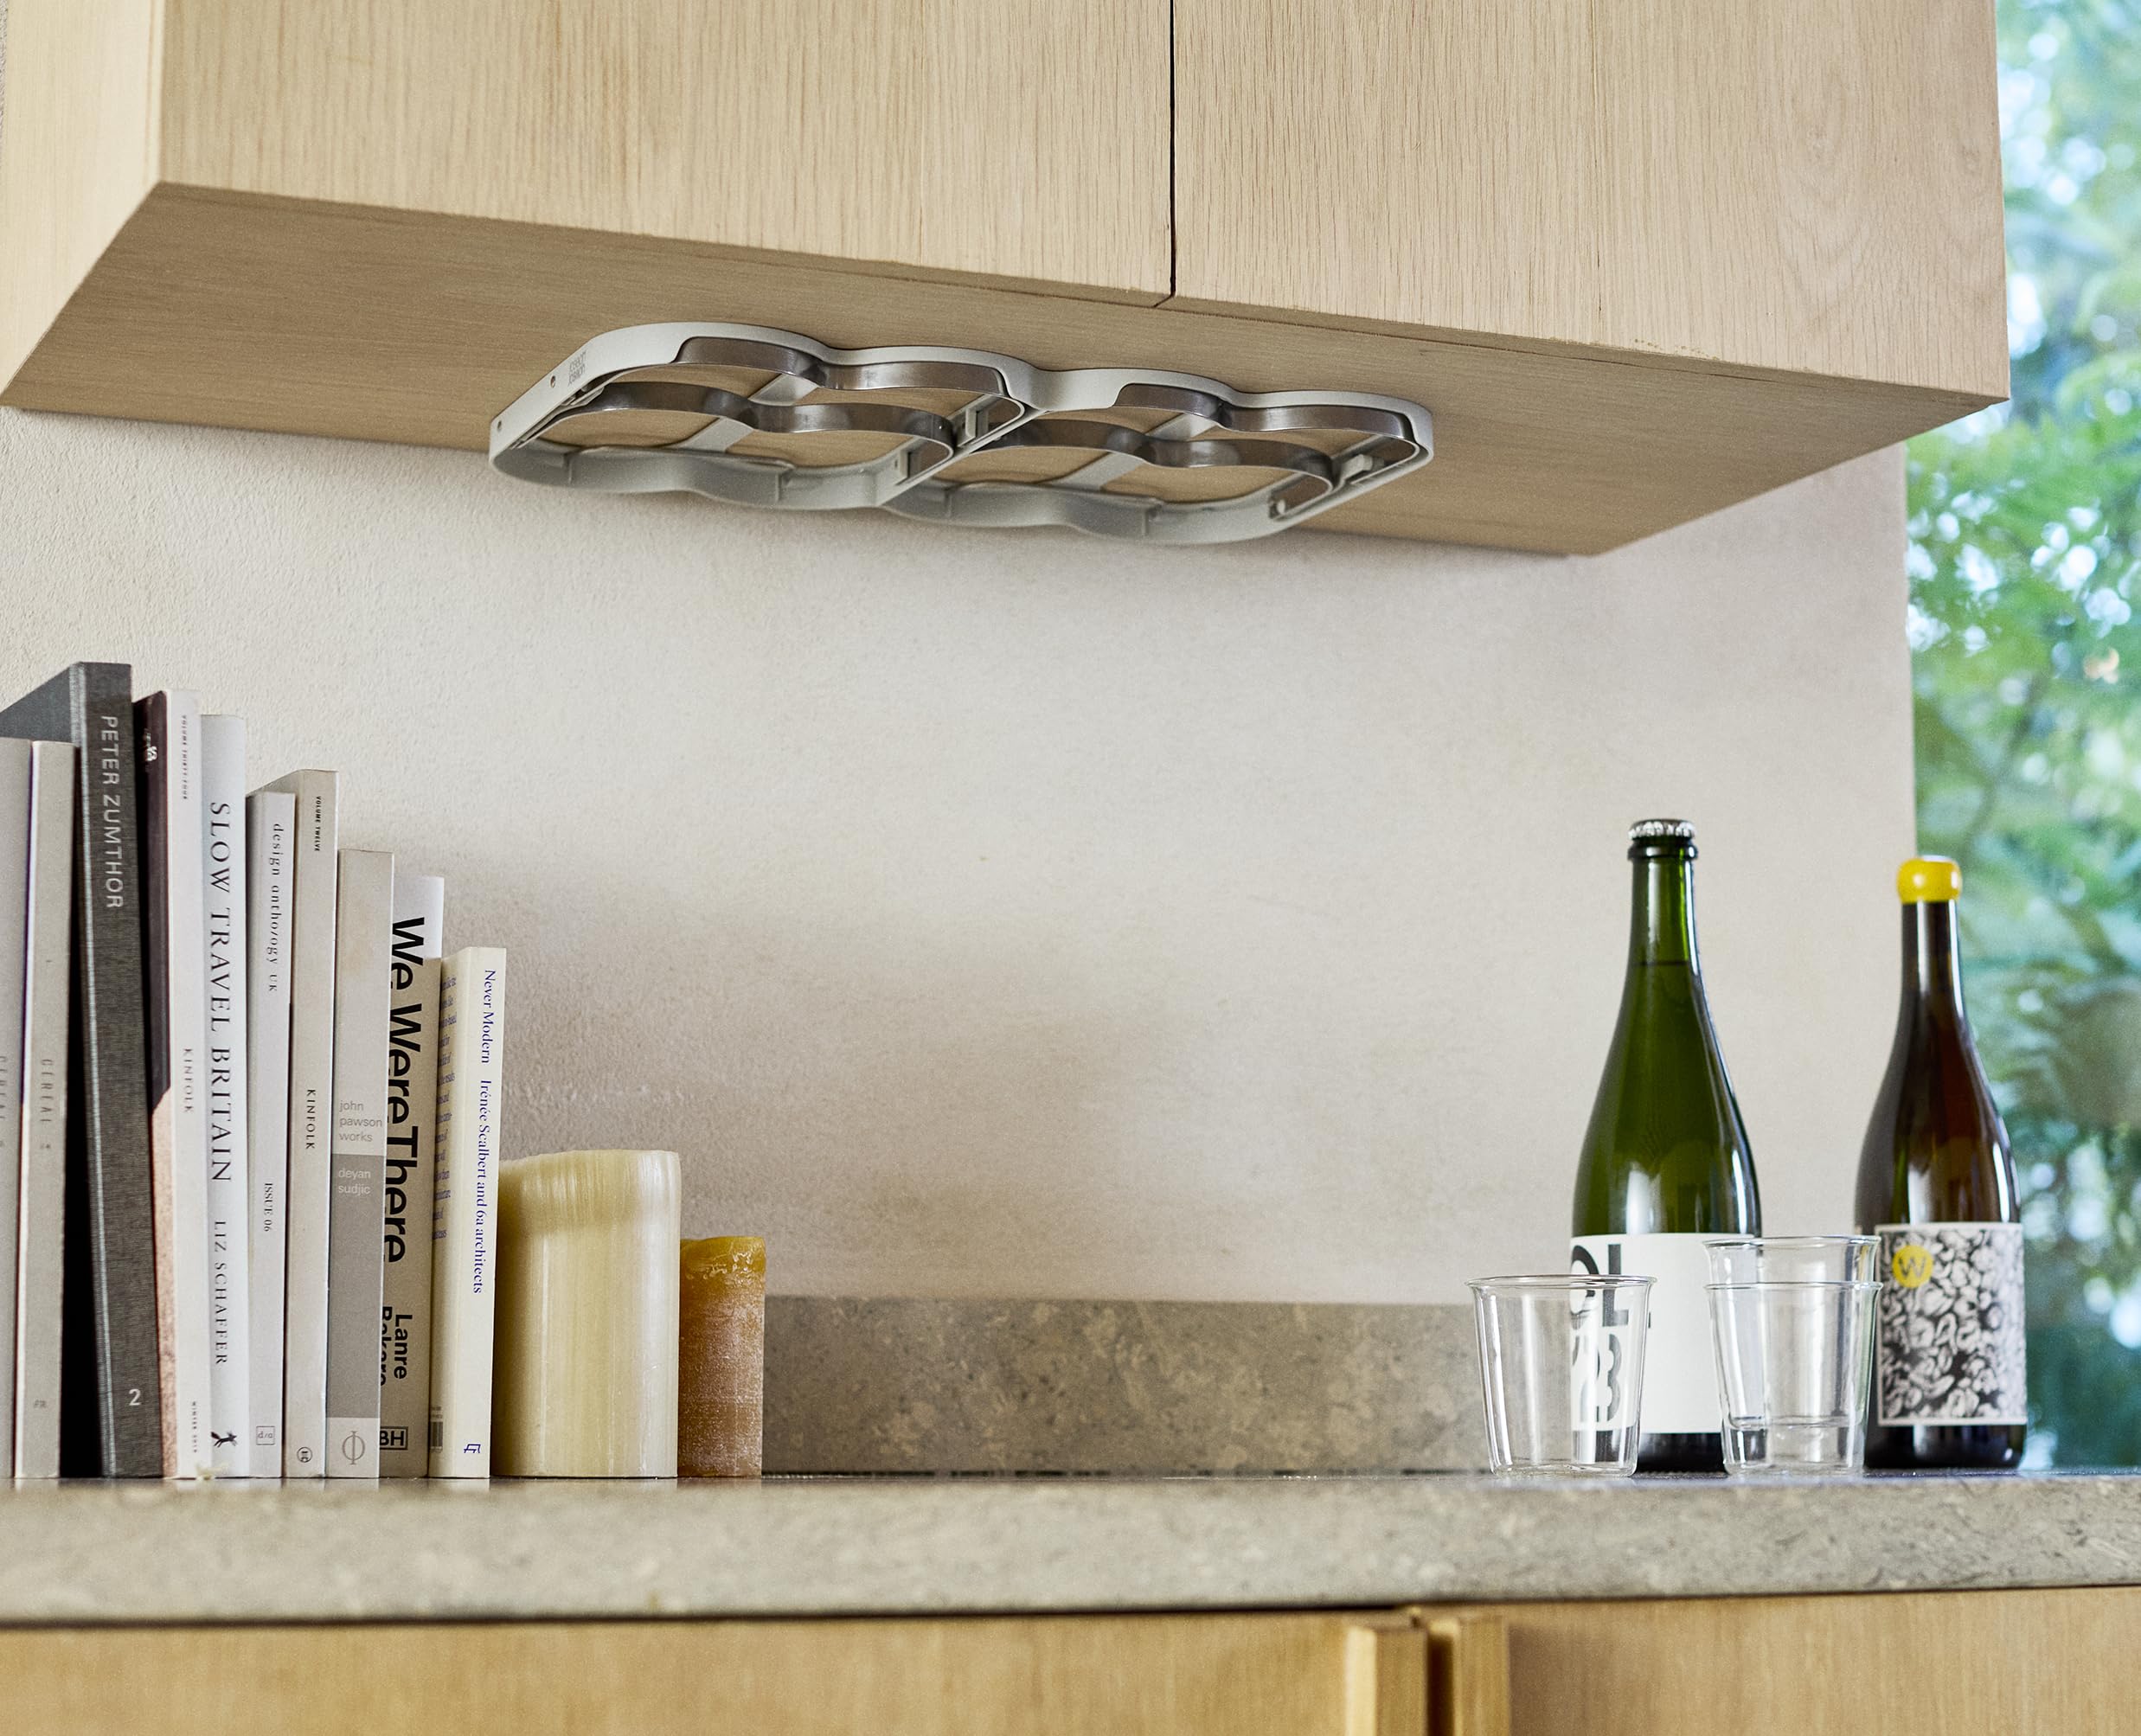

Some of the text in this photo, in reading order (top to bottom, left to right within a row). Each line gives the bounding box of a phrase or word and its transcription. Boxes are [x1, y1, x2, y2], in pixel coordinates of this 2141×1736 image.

[101, 715, 124, 907] PETER ZUMTHOR
[269, 823, 284, 876] design
[210, 802, 232, 1182] SLOW TRAVEL BRITAIN
[269, 974, 278, 992] UK
[183, 1048, 194, 1113] KINFOLK
[339, 1099, 363, 1112] john
[384, 917, 425, 1263] We Were There
[305, 1089, 317, 1150] KINFOLK
[339, 1118, 382, 1128] pawson
[339, 1132, 373, 1142] works
[472, 970, 497, 1294] Never Modern Irénée Scalbert and 6a architects
[338, 1169, 371, 1181] deyan
[338, 1183, 371, 1196] sudjic
[263, 1182, 273, 1232] ISSUE 06
[214, 1220, 228, 1365] LIZ SCHAFFER
[394, 1314, 413, 1380] Lanre
[129, 1388, 142, 1406] 2
